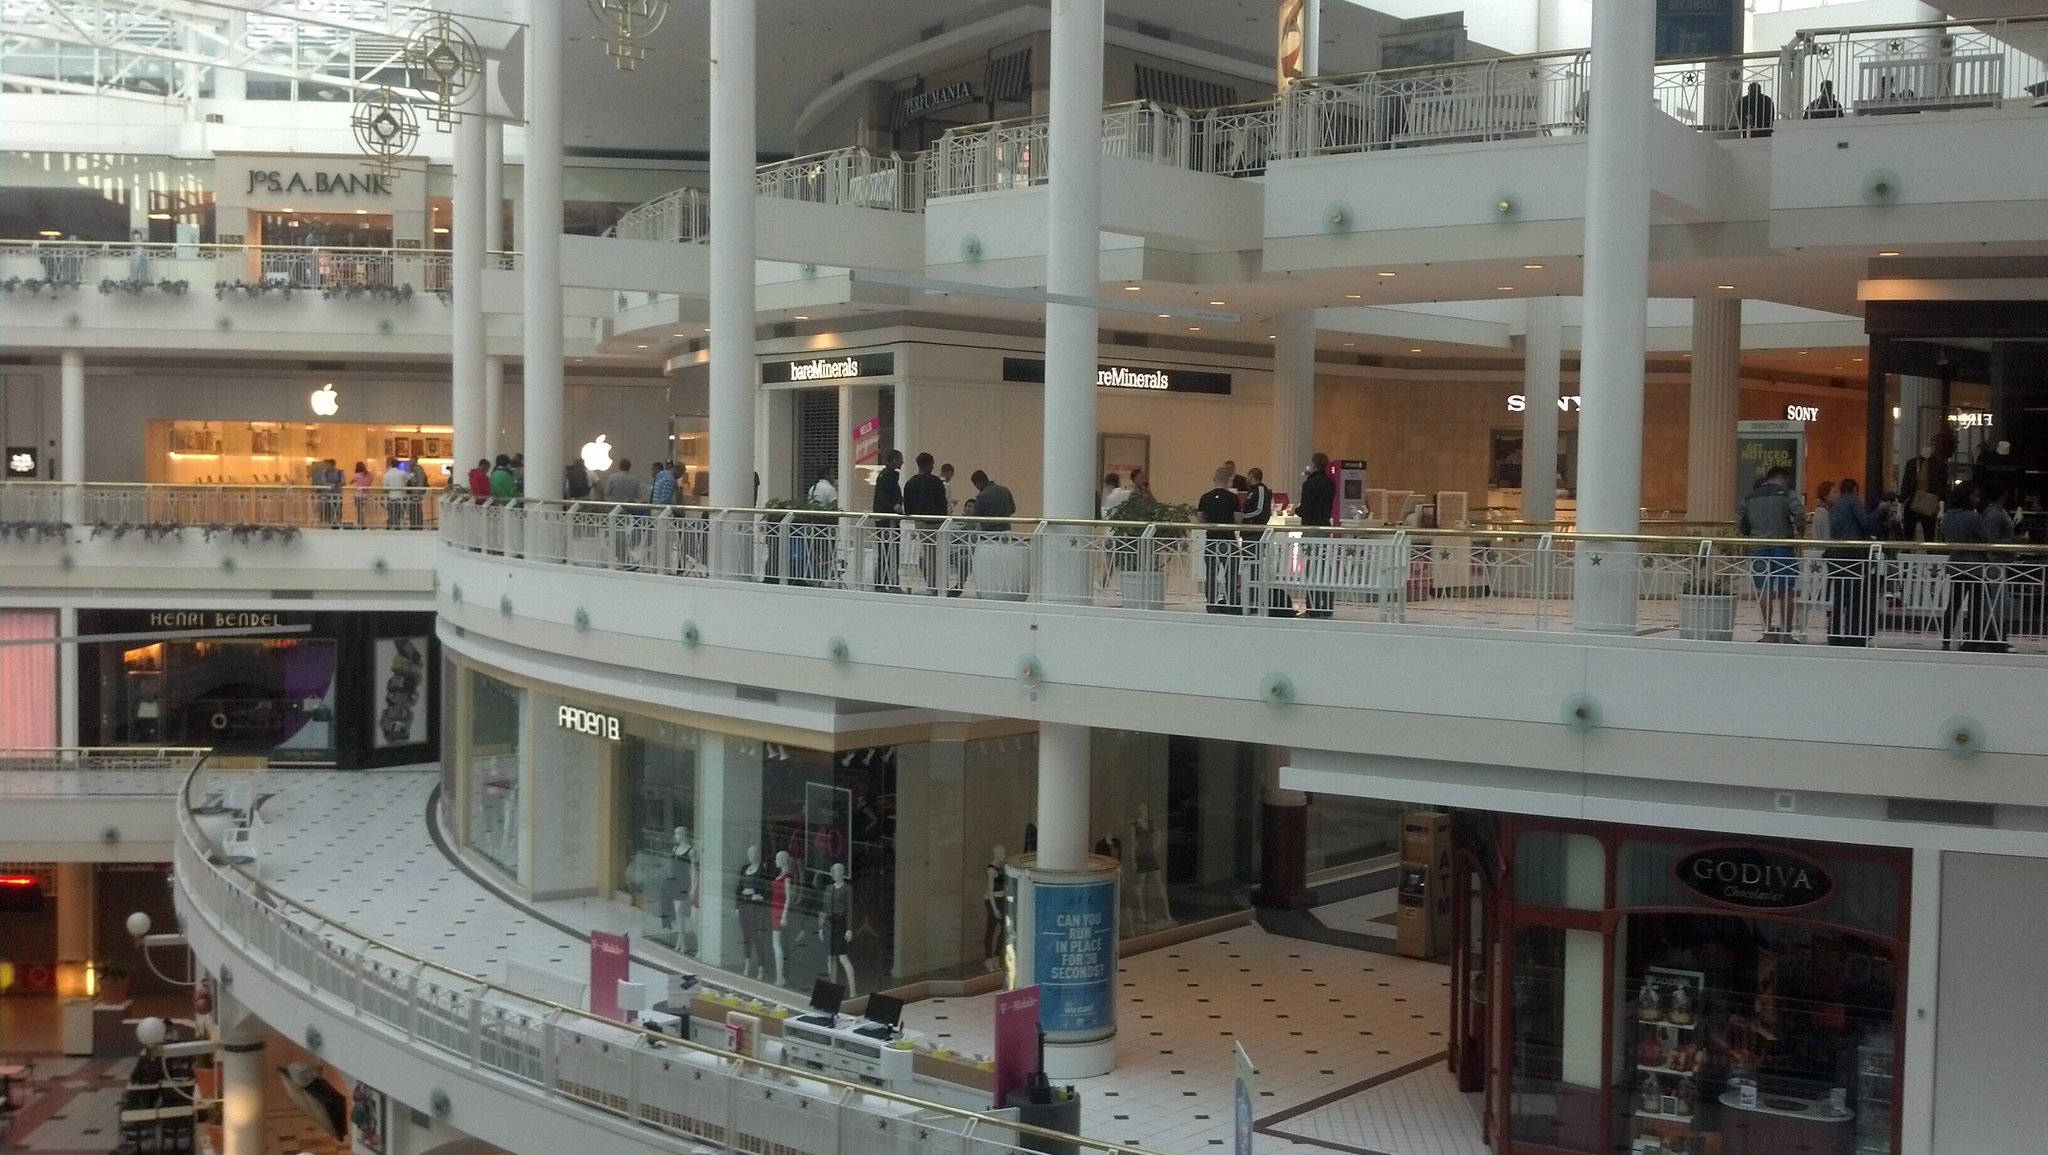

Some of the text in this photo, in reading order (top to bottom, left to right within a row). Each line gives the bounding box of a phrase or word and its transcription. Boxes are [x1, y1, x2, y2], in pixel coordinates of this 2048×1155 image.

[315, 171, 392, 195] BANK
[790, 357, 858, 381] bareMinerals
[1097, 367, 1169, 390] reMinerals
[1787, 405, 1819, 421] SONY
[1742, 450, 1789, 460] NOTICED
[151, 612, 281, 627] HENRI BENDEL
[1693, 858, 1813, 890] GODIVA
[1057, 912, 1102, 928] CAN YOU
[1069, 926, 1093, 940] RUN
[1055, 939, 1103, 954] IN PLACE
[1061, 952, 1098, 967] FOR 30
[1051, 963, 1105, 980] SECONDS?
